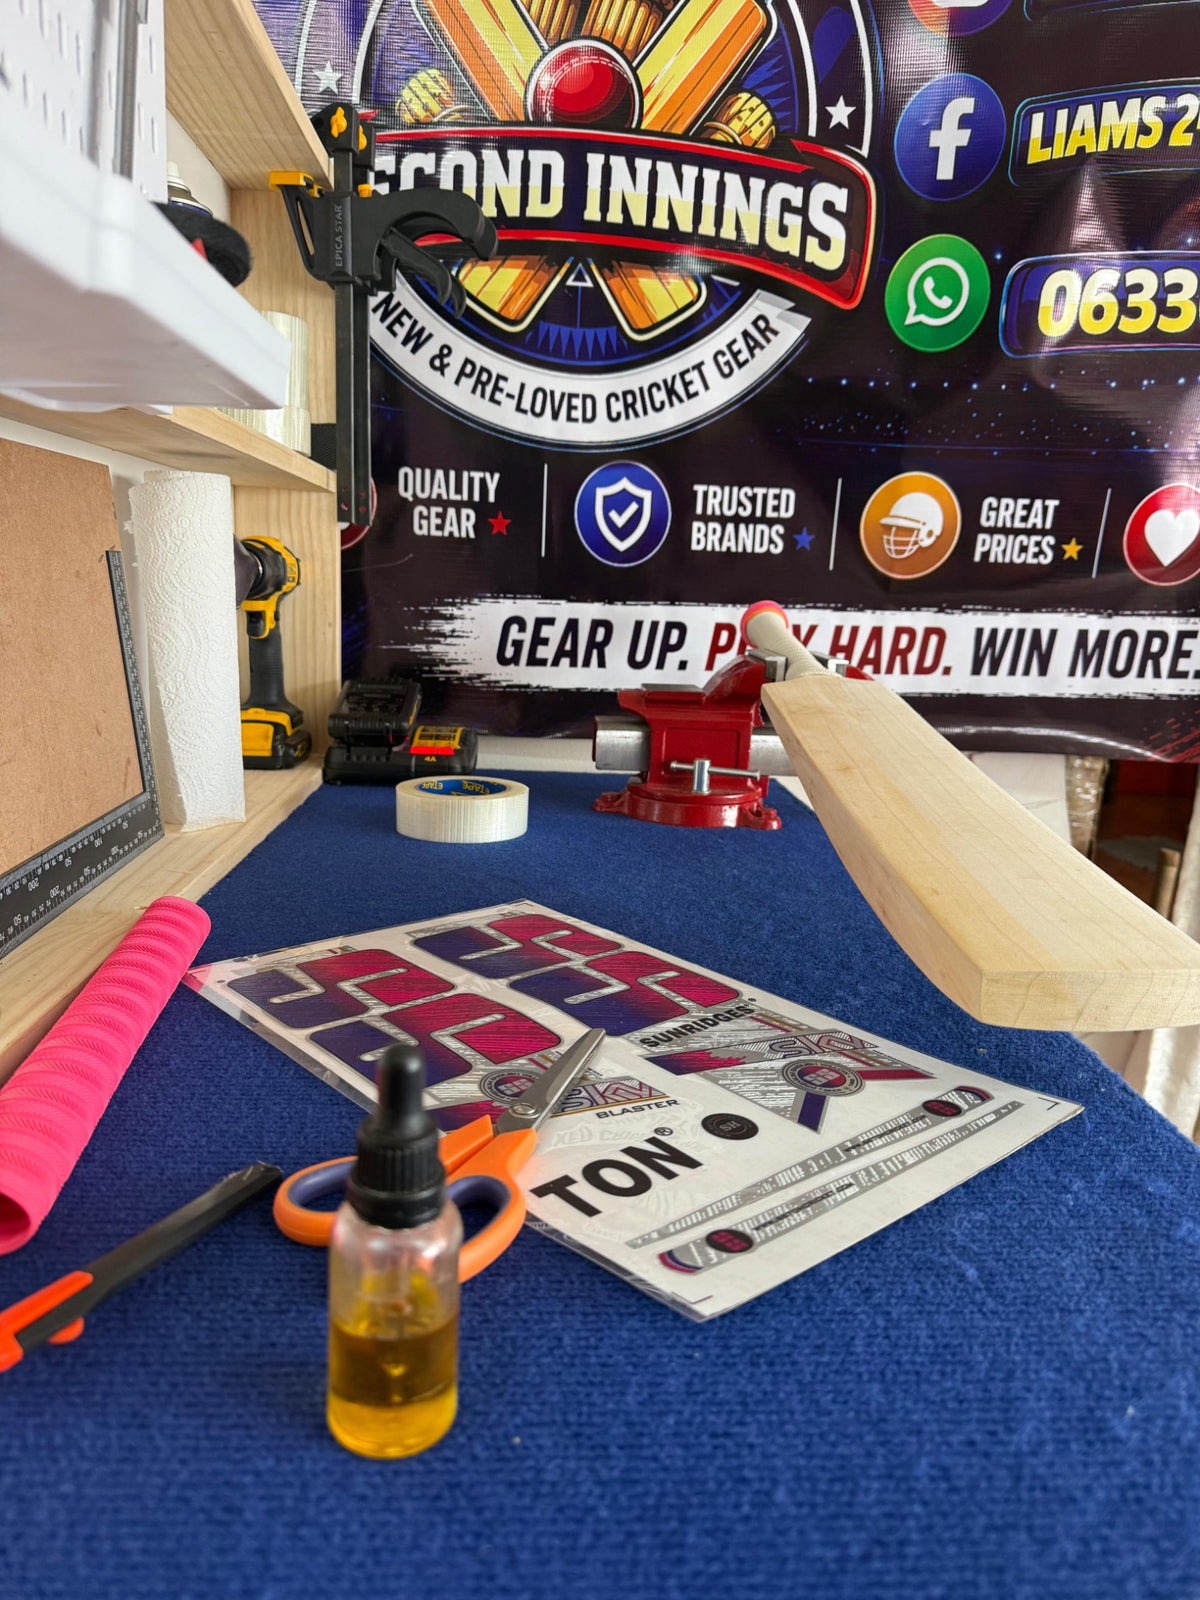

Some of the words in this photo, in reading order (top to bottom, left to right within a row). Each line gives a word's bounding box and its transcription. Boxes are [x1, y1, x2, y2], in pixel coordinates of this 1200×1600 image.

[1027, 96, 1164, 165] LIAMS
[1168, 93, 1200, 147] 2
[335, 205, 343, 233] STAR
[584, 153, 849, 272] INNINGS
[335, 236, 343, 267] EPICA
[371, 291, 434, 355] NEW
[429, 343, 453, 377] &
[454, 356, 597, 424] PRE-LOVED
[605, 360, 711, 423] CRICKET
[712, 313, 781, 380] GEAR
[398, 466, 500, 503] QUALITY
[693, 484, 796, 518] TRUSTED
[412, 505, 476, 539] GEAR
[979, 496, 1061, 530] GREAT
[691, 521, 785, 555] BRANDS
[973, 532, 1056, 565] PRICES
[497, 615, 614, 670] GEAR
[627, 620, 689, 671] UP.
[704, 622, 819, 672] PY
[828, 624, 953, 676] HARD.
[970, 626, 1058, 679] WIN
[1067, 628, 1200, 680] MORE.
[28, 877, 40, 891] 200
[50, 884, 60, 898] 200
[13, 913, 22, 926] 50
[640, 1005, 755, 1048] SUNRIDGES
[595, 1099, 680, 1119] BLASTER
